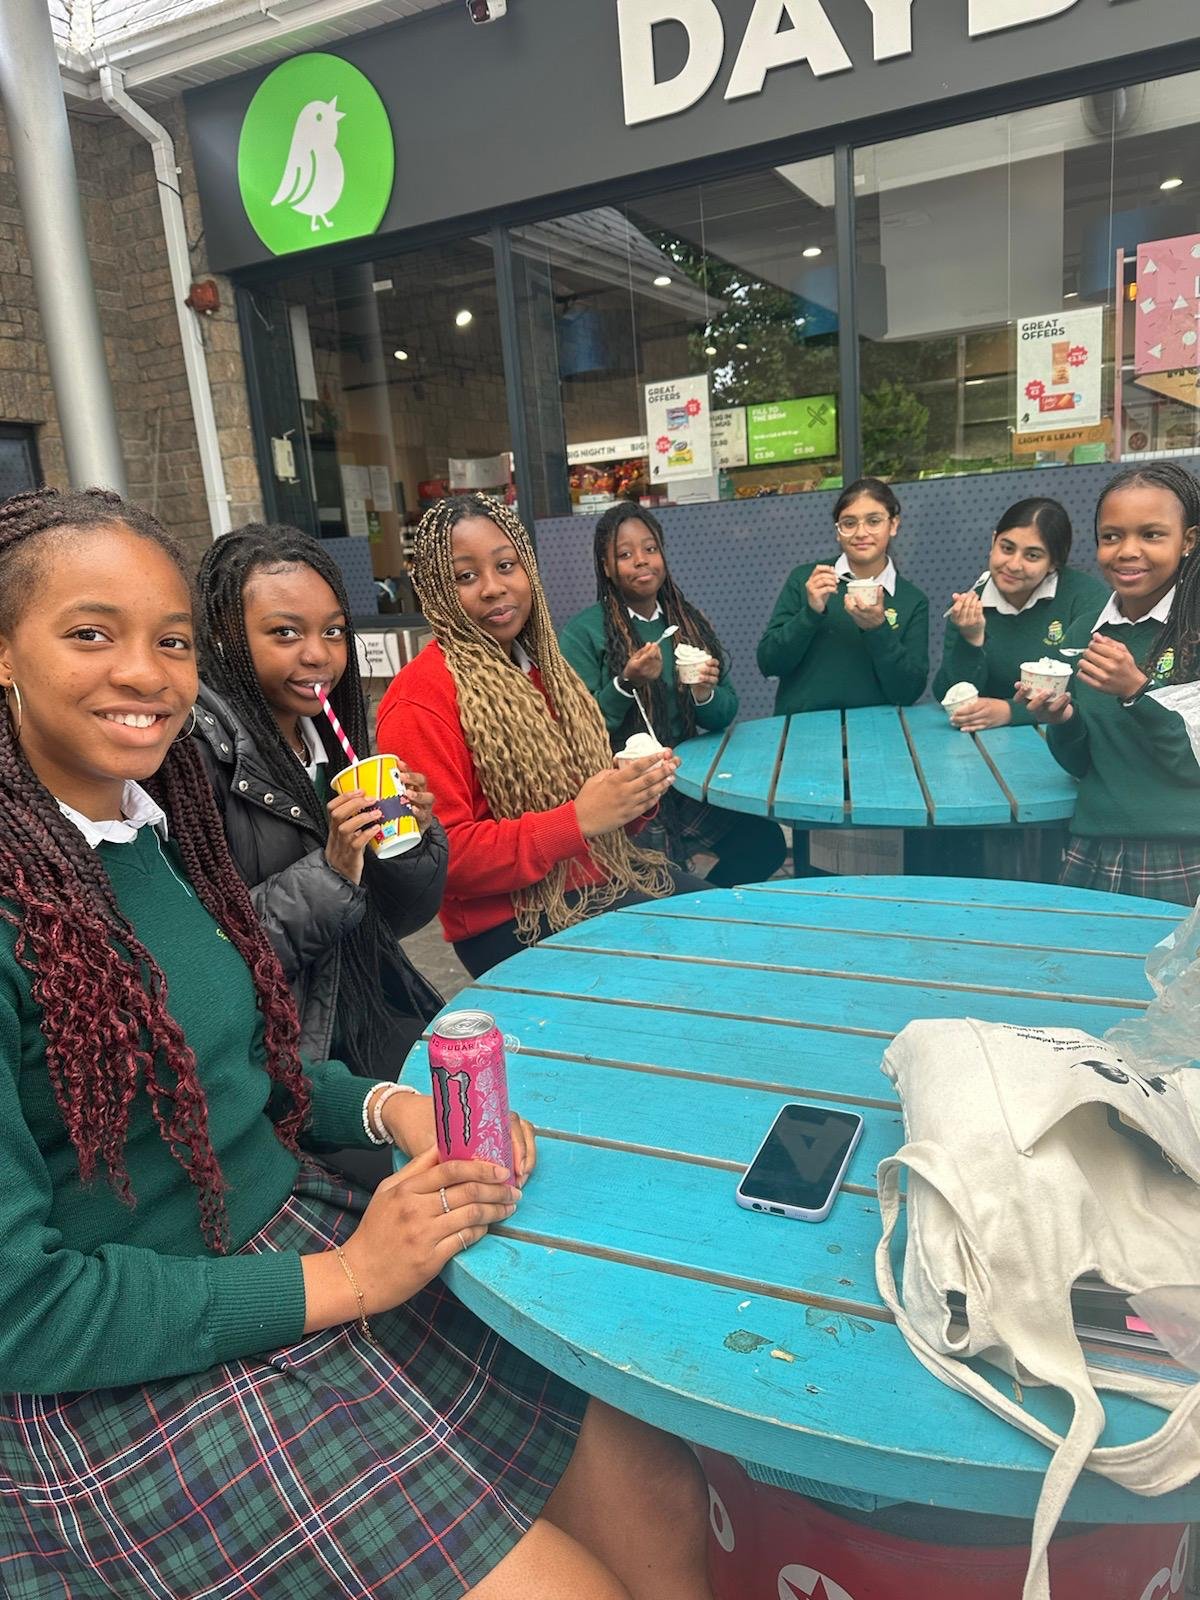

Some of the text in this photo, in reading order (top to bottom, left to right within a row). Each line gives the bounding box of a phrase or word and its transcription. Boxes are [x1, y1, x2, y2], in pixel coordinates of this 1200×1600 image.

[1022, 319, 1059, 332] GREAT
[1022, 327, 1065, 340] OFFERS
[648, 385, 675, 396] GREAT
[648, 393, 681, 404] OFFERS
[1017, 437, 1044, 445] LIGHT
[1054, 432, 1083, 441] LEAFY
[580, 447, 605, 456] NIGHT
[606, 446, 616, 454] IN
[630, 443, 645, 451] BIG
